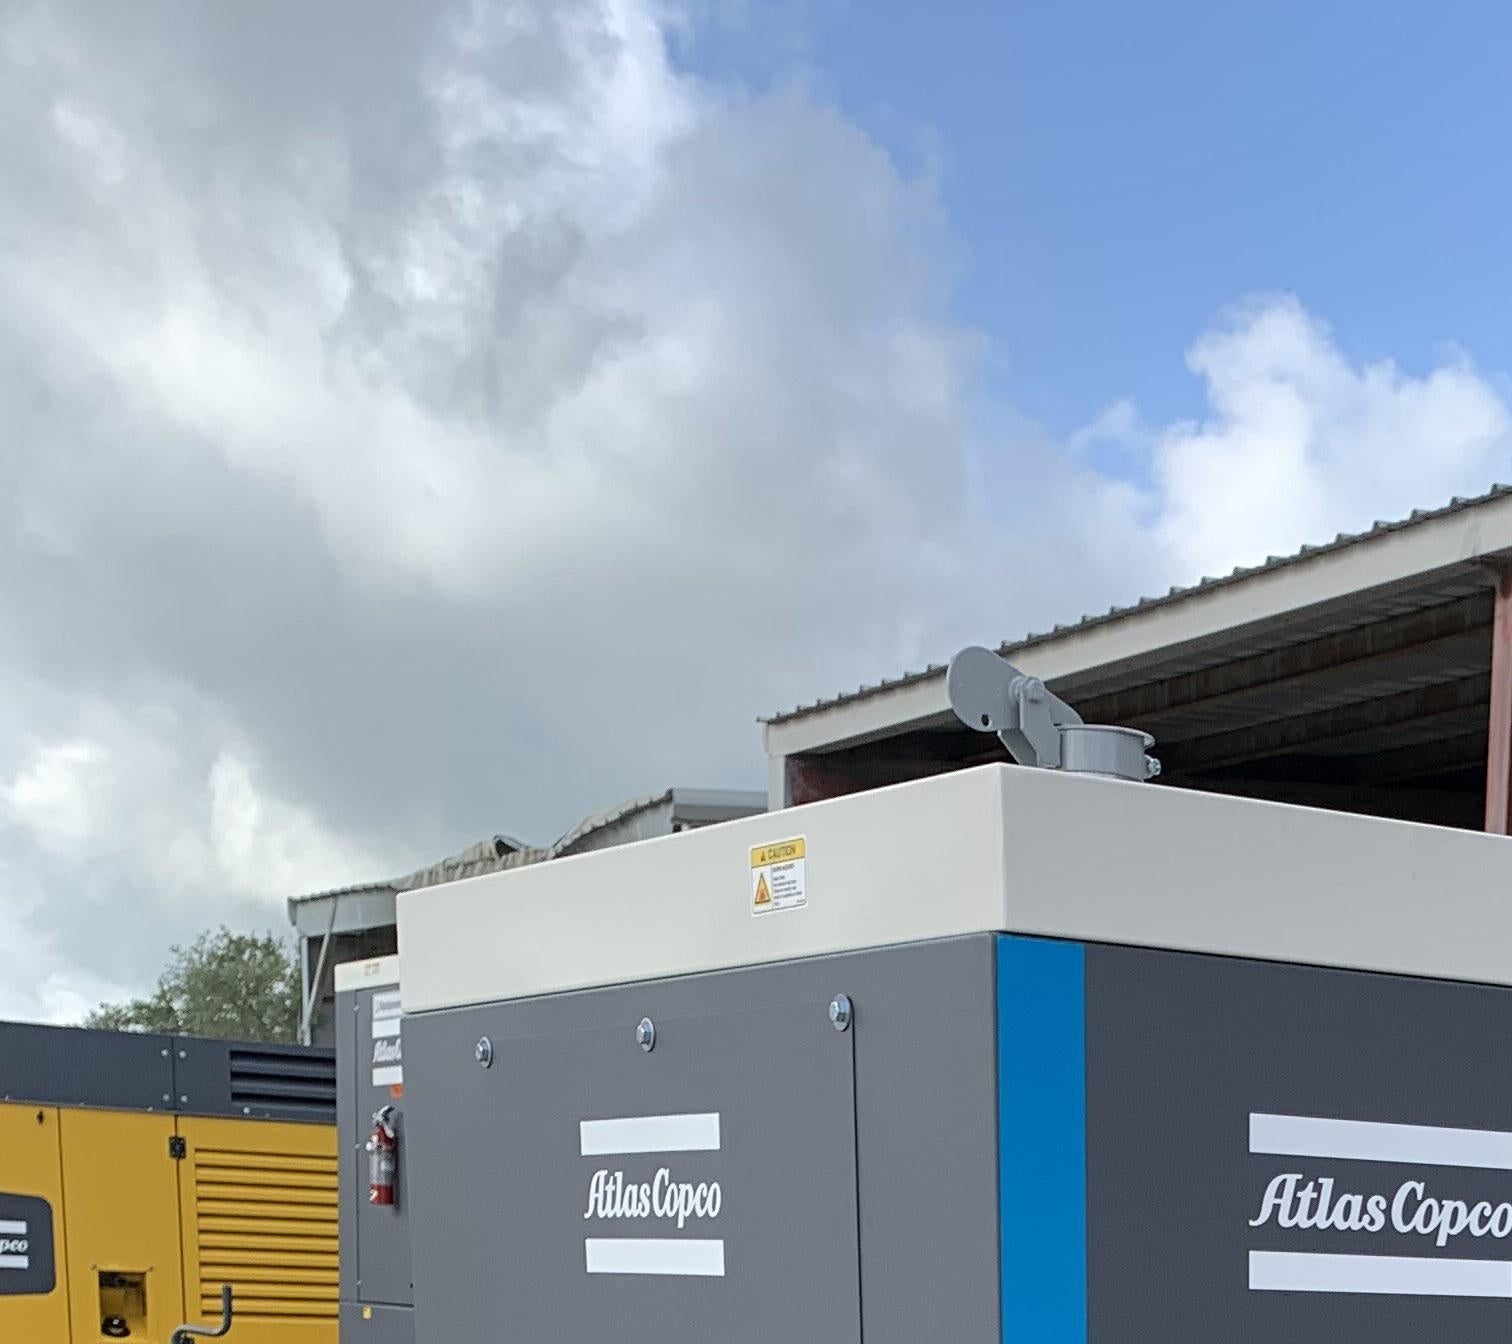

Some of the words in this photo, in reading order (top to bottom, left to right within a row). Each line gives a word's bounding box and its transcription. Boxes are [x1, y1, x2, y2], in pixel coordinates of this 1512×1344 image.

[583, 1168, 650, 1219] Atlas
[652, 1166, 722, 1229] Copco
[1248, 1172, 1387, 1233] Atlas
